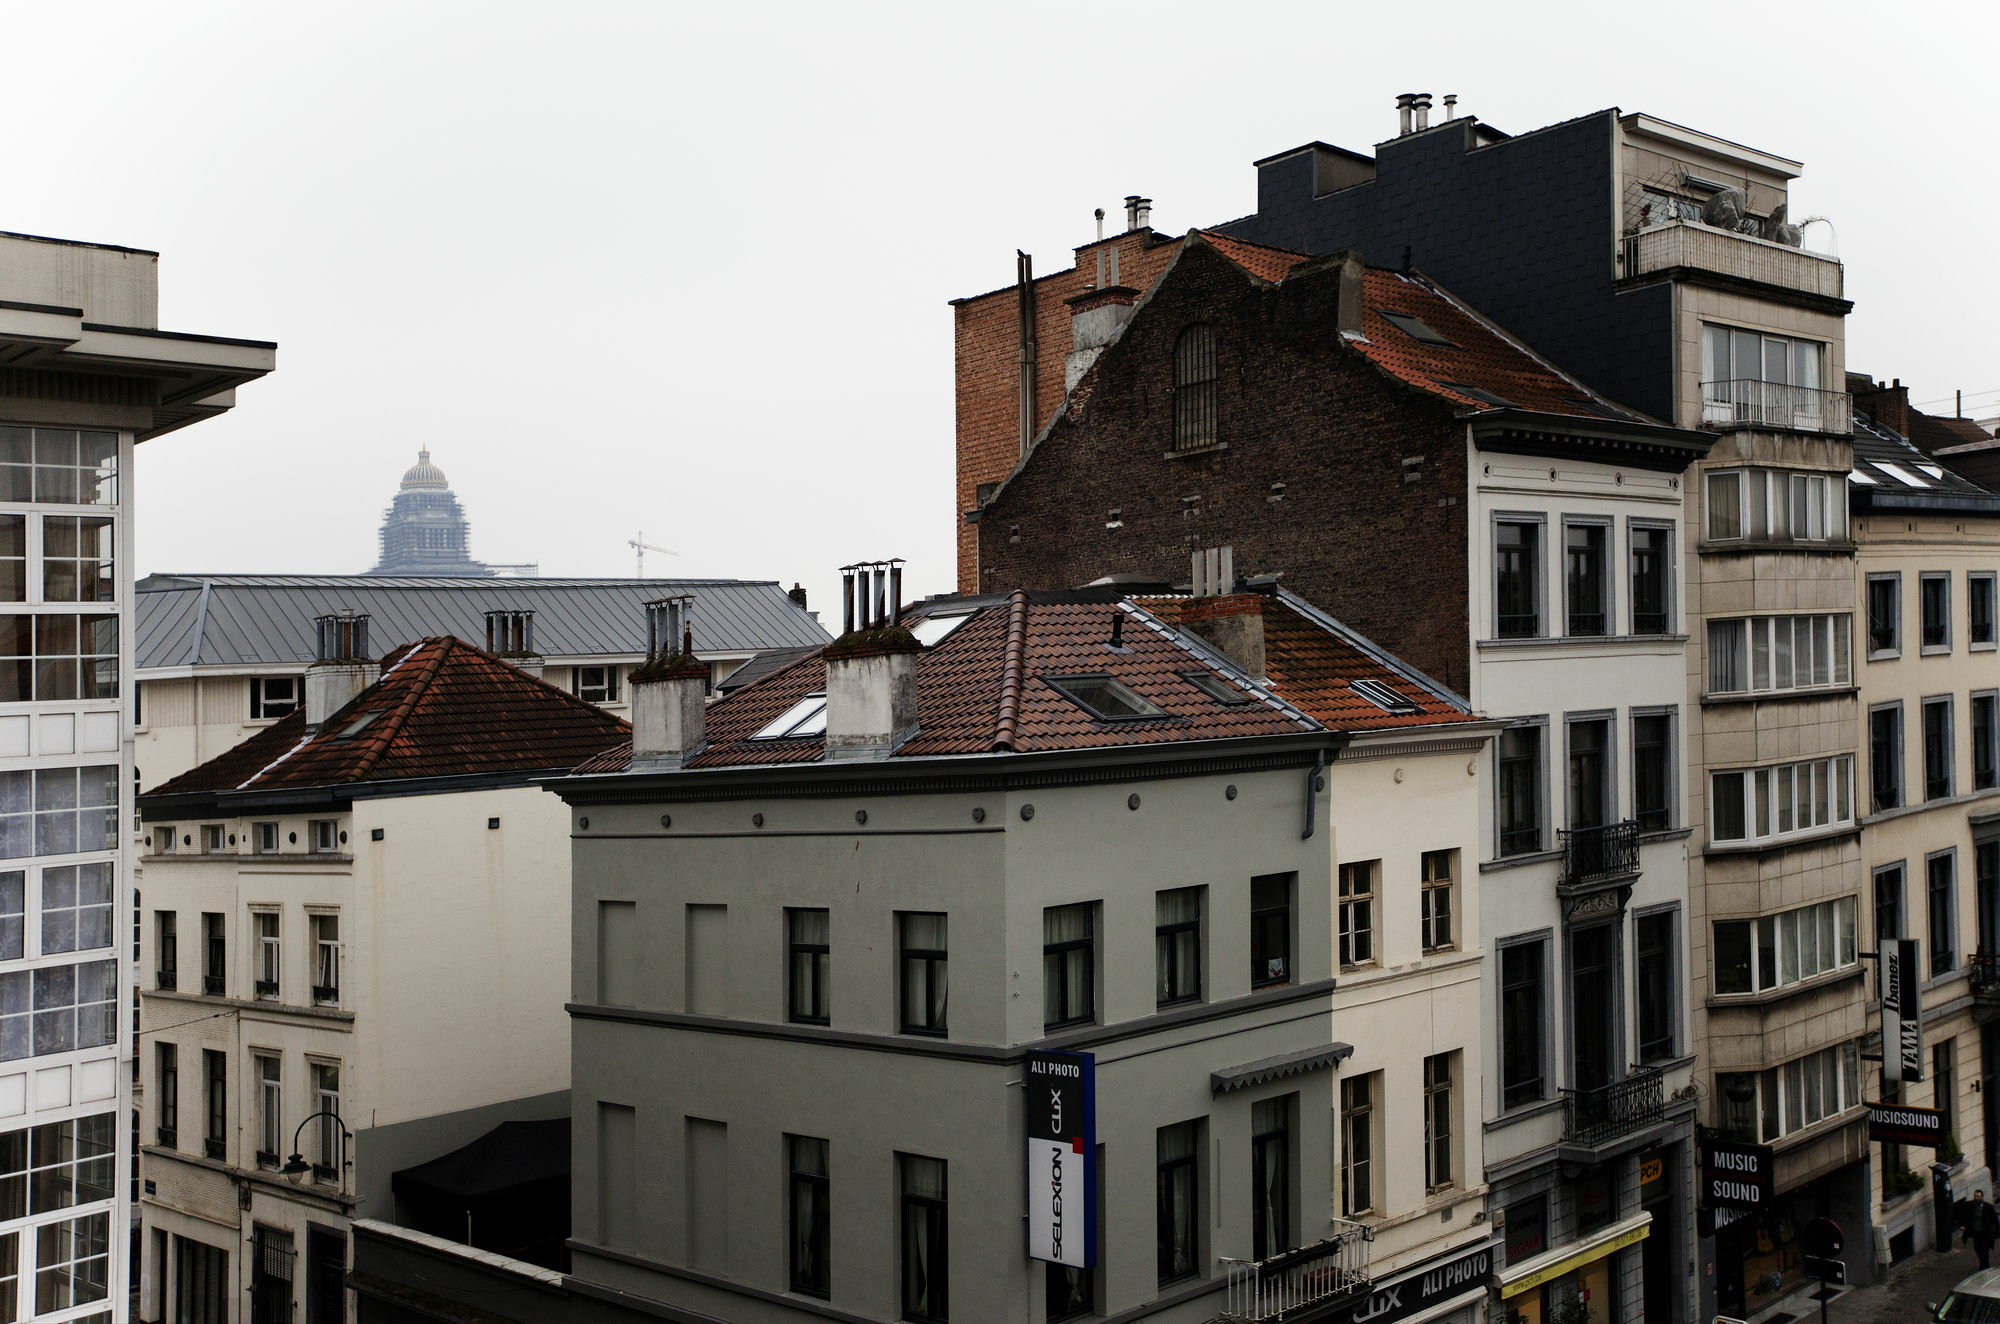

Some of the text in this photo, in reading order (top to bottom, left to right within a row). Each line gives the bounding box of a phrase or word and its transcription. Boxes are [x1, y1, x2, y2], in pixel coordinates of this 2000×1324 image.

[1883, 953, 1899, 1014] Ibanez
[1900, 1019, 1918, 1072] TAMA
[1031, 1060, 1080, 1078] ALI PHOTO
[1868, 1109, 1940, 1129] MUSICSOUND
[1641, 1162, 1660, 1181] PCH
[1713, 1150, 1758, 1173] MUSIC
[1713, 1179, 1760, 1203] SOUND
[1507, 1235, 1541, 1258] SIGMA
[1421, 1251, 1488, 1298] ALI PHOTO
